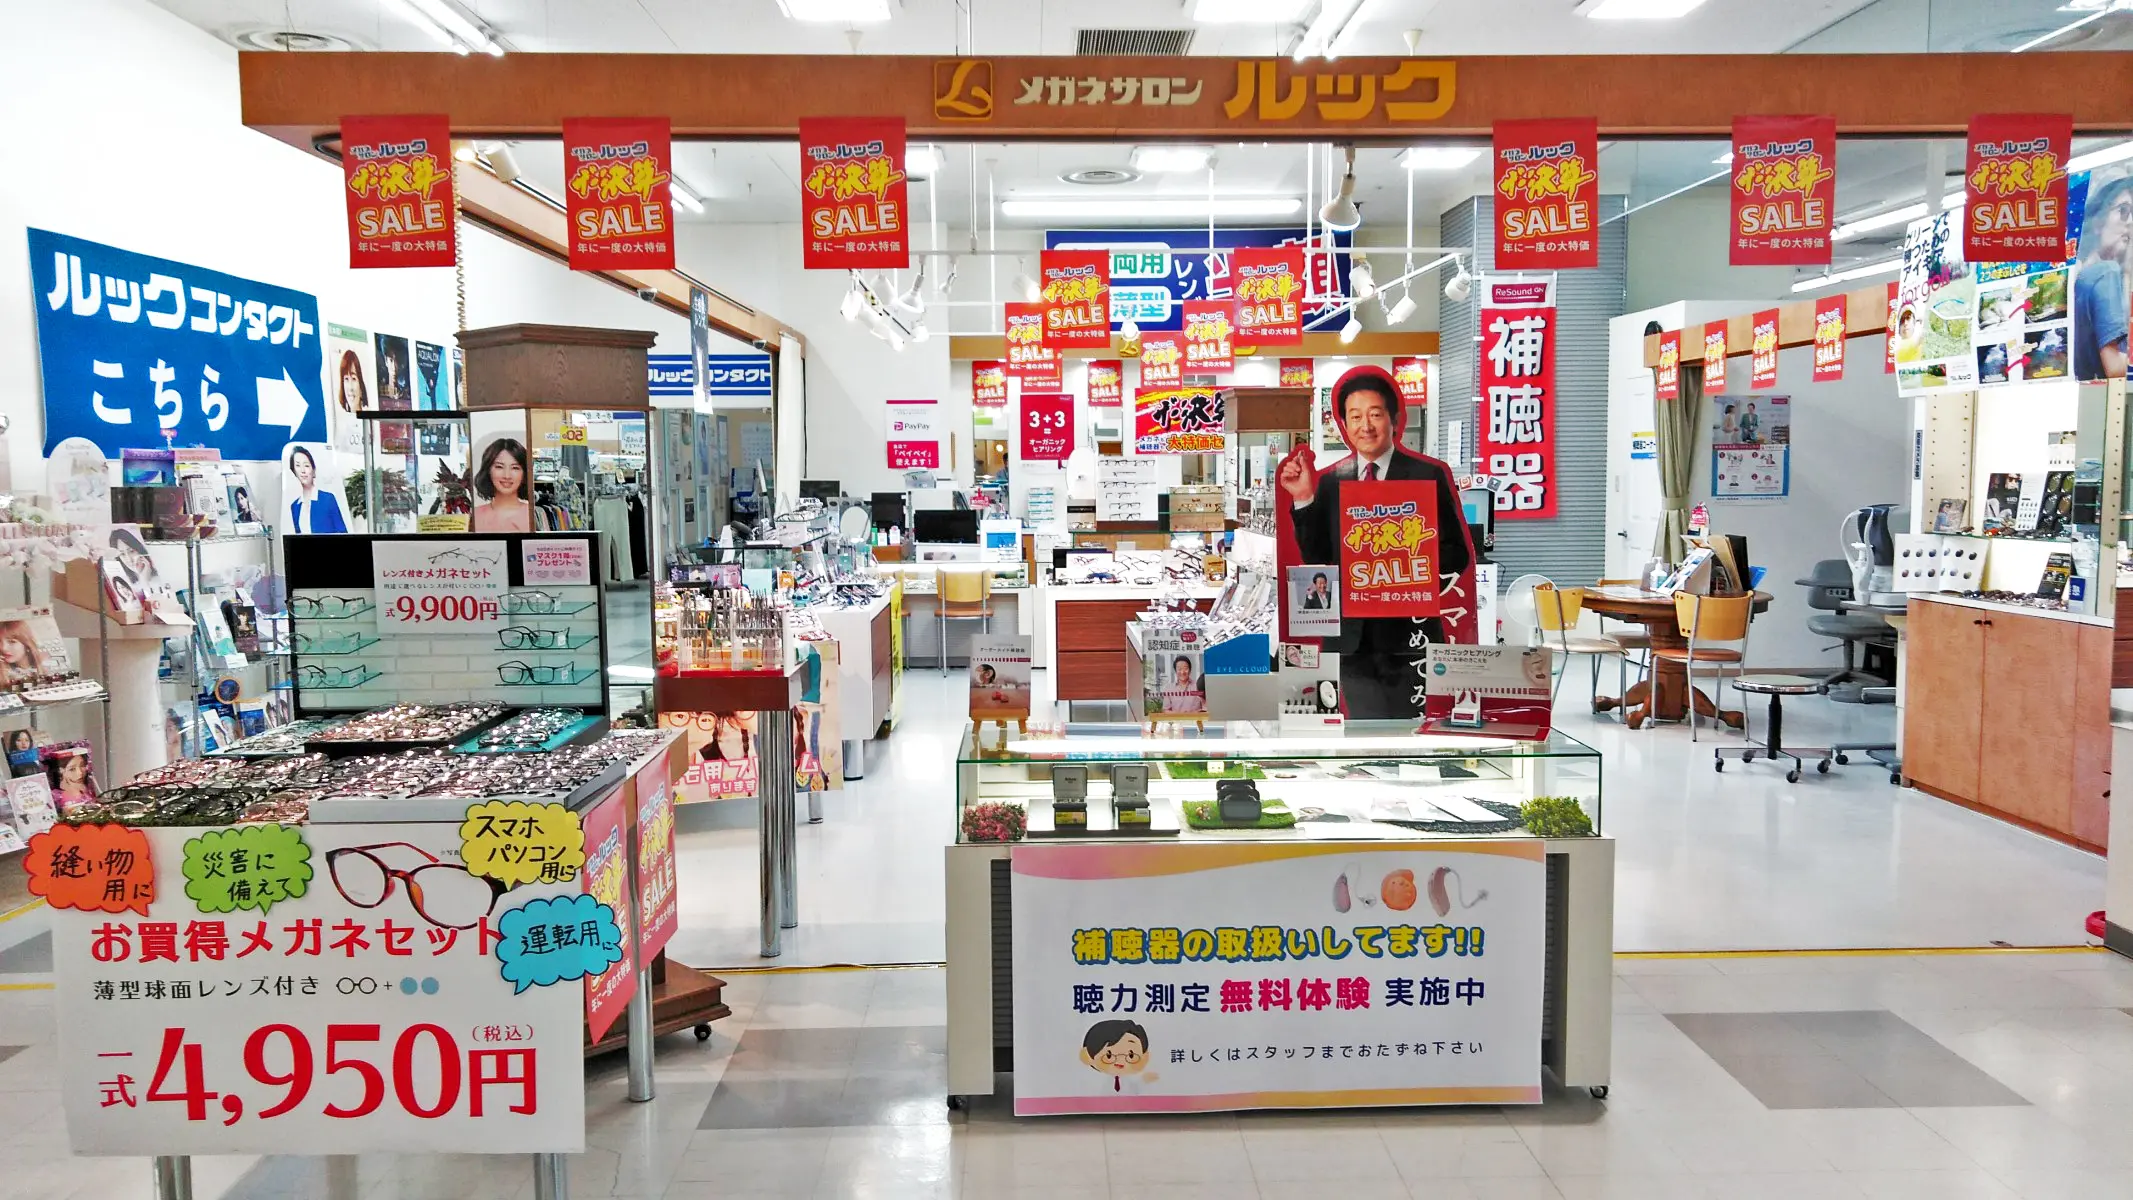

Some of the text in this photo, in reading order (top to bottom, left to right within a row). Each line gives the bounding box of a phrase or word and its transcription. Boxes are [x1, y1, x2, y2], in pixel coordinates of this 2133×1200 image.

[1014, 61, 1457, 120] メガネサロン ルック
[378, 138, 427, 158] ルック
[599, 141, 648, 158] ルック
[835, 140, 883, 158] ルック
[1528, 141, 1576, 159] ルック
[1765, 138, 1814, 156] ルック
[1999, 137, 2049, 154] ルック
[357, 201, 444, 239] SALE
[576, 202, 665, 240] SALE
[812, 202, 899, 238] SALE
[1502, 201, 1590, 239] SALE
[1739, 199, 1825, 235] SALE
[1973, 198, 2059, 234] SALE
[358, 240, 447, 252] 年に一度の大特価
[578, 242, 666, 253] 年に一度の大特価
[812, 241, 901, 252] 年に一度の大特価
[1503, 241, 1590, 253] 年に一度の大特価
[1738, 237, 1825, 249] 年に一度の大特価
[1971, 236, 2058, 248] 年に一度の大特価
[47, 250, 314, 349] ルックコンタクト
[1495, 287, 1533, 296] ReSound
[1048, 304, 1105, 329] SALE
[1239, 303, 1298, 326] SALE
[1010, 346, 1054, 363] SALE
[1187, 341, 1231, 361] SALE
[1753, 351, 1775, 374] SALE
[1816, 341, 1842, 366] SALE
[1659, 367, 1677, 386] SALE
[1705, 359, 1724, 380] SALE
[92, 358, 230, 432] こちら
[977, 387, 1004, 399] SALE
[1091, 385, 1120, 398] SALE
[1488, 315, 1546, 512] 補聴器
[905, 422, 931, 432] PayPay
[1029, 438, 1066, 446] オーガニック
[1373, 502, 1416, 517] ルック
[383, 568, 491, 579] レンズ付きメガネセット
[1350, 558, 1431, 588] SALE
[1350, 592, 1432, 602] 年に一度の大特価
[385, 601, 395, 617] 一式
[396, 596, 498, 622] 9,900円
[1432, 648, 1502, 657] オーガニックヒアリング
[710, 780, 756, 793] あります
[476, 816, 545, 839] スマホ
[51, 844, 134, 879] 縫い物
[202, 849, 275, 879] 災害に
[487, 844, 566, 864] パソコン
[540, 862, 577, 879] 用に
[102, 879, 151, 902] 用に
[227, 877, 292, 902] 備えて
[642, 854, 674, 927] SALE
[91, 915, 503, 965] お買得メガネセット
[520, 920, 615, 957] 運転用に
[1072, 925, 1485, 967] 補聴器の取扱いしてます!!
[93, 976, 320, 1001] 薄型球面レンズ付き
[1072, 977, 1486, 1015] 聴力測定 無料体験 実施中
[1170, 1040, 1485, 1064] 詳しくはスタッフまでおたずね下さい
[98, 1051, 137, 1109] 一式
[146, 1022, 537, 1127] 4,950円
